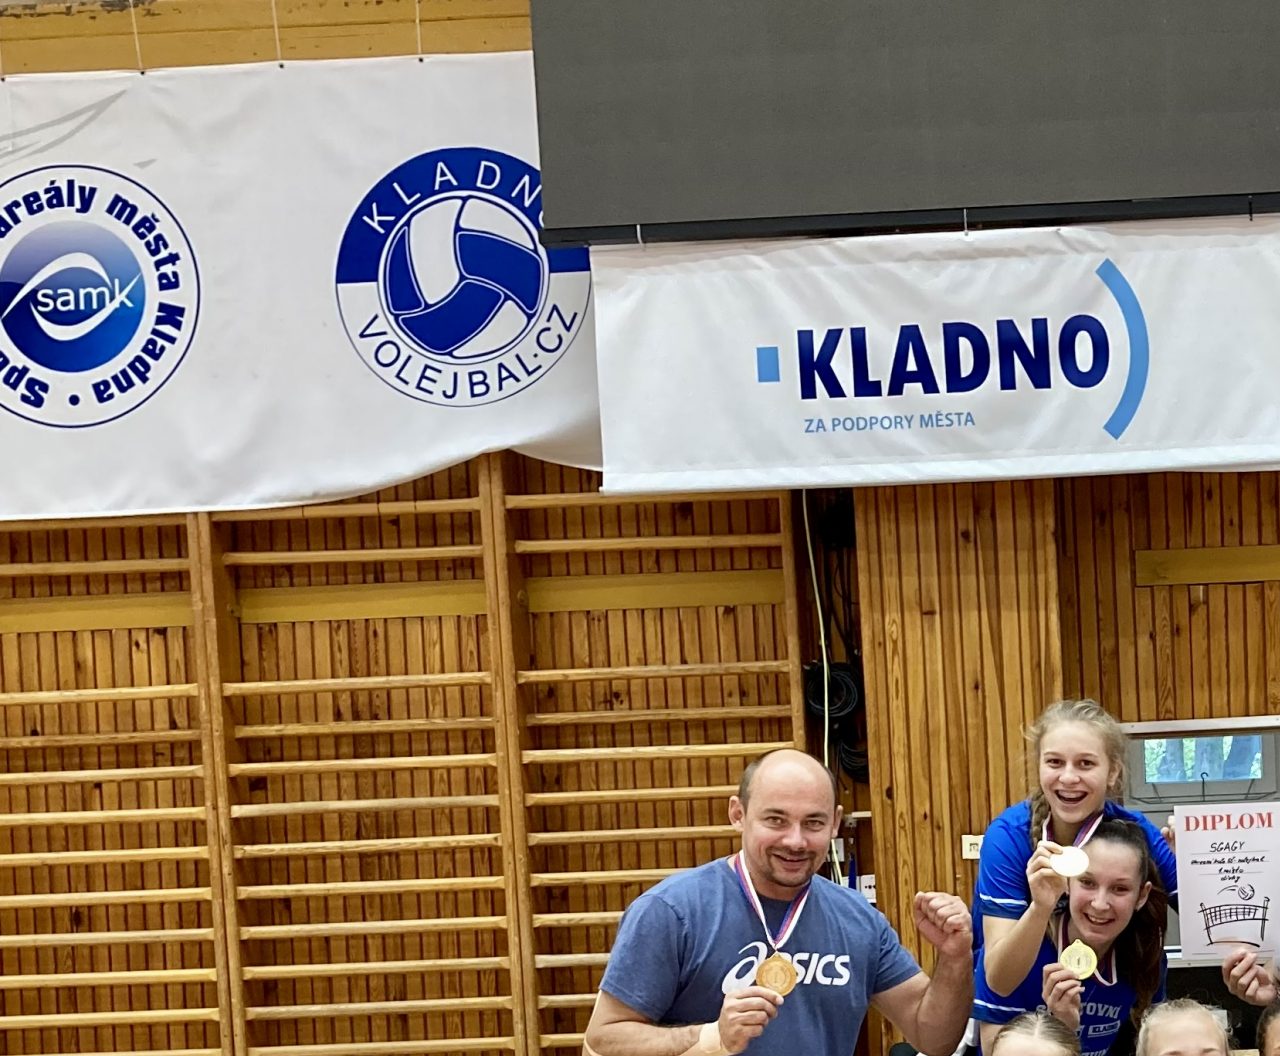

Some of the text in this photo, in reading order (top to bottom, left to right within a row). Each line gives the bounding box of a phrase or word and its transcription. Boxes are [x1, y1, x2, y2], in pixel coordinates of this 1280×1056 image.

[363, 160, 545, 235] KLADN
[105, 193, 181, 292] města
[36, 278, 135, 312] samk
[91, 301, 186, 404] Kladna
[797, 313, 1110, 401] KLADNO
[804, 409, 976, 434] ZA PODPORY MĚSTA
[1184, 812, 1273, 832] DIPLOM
